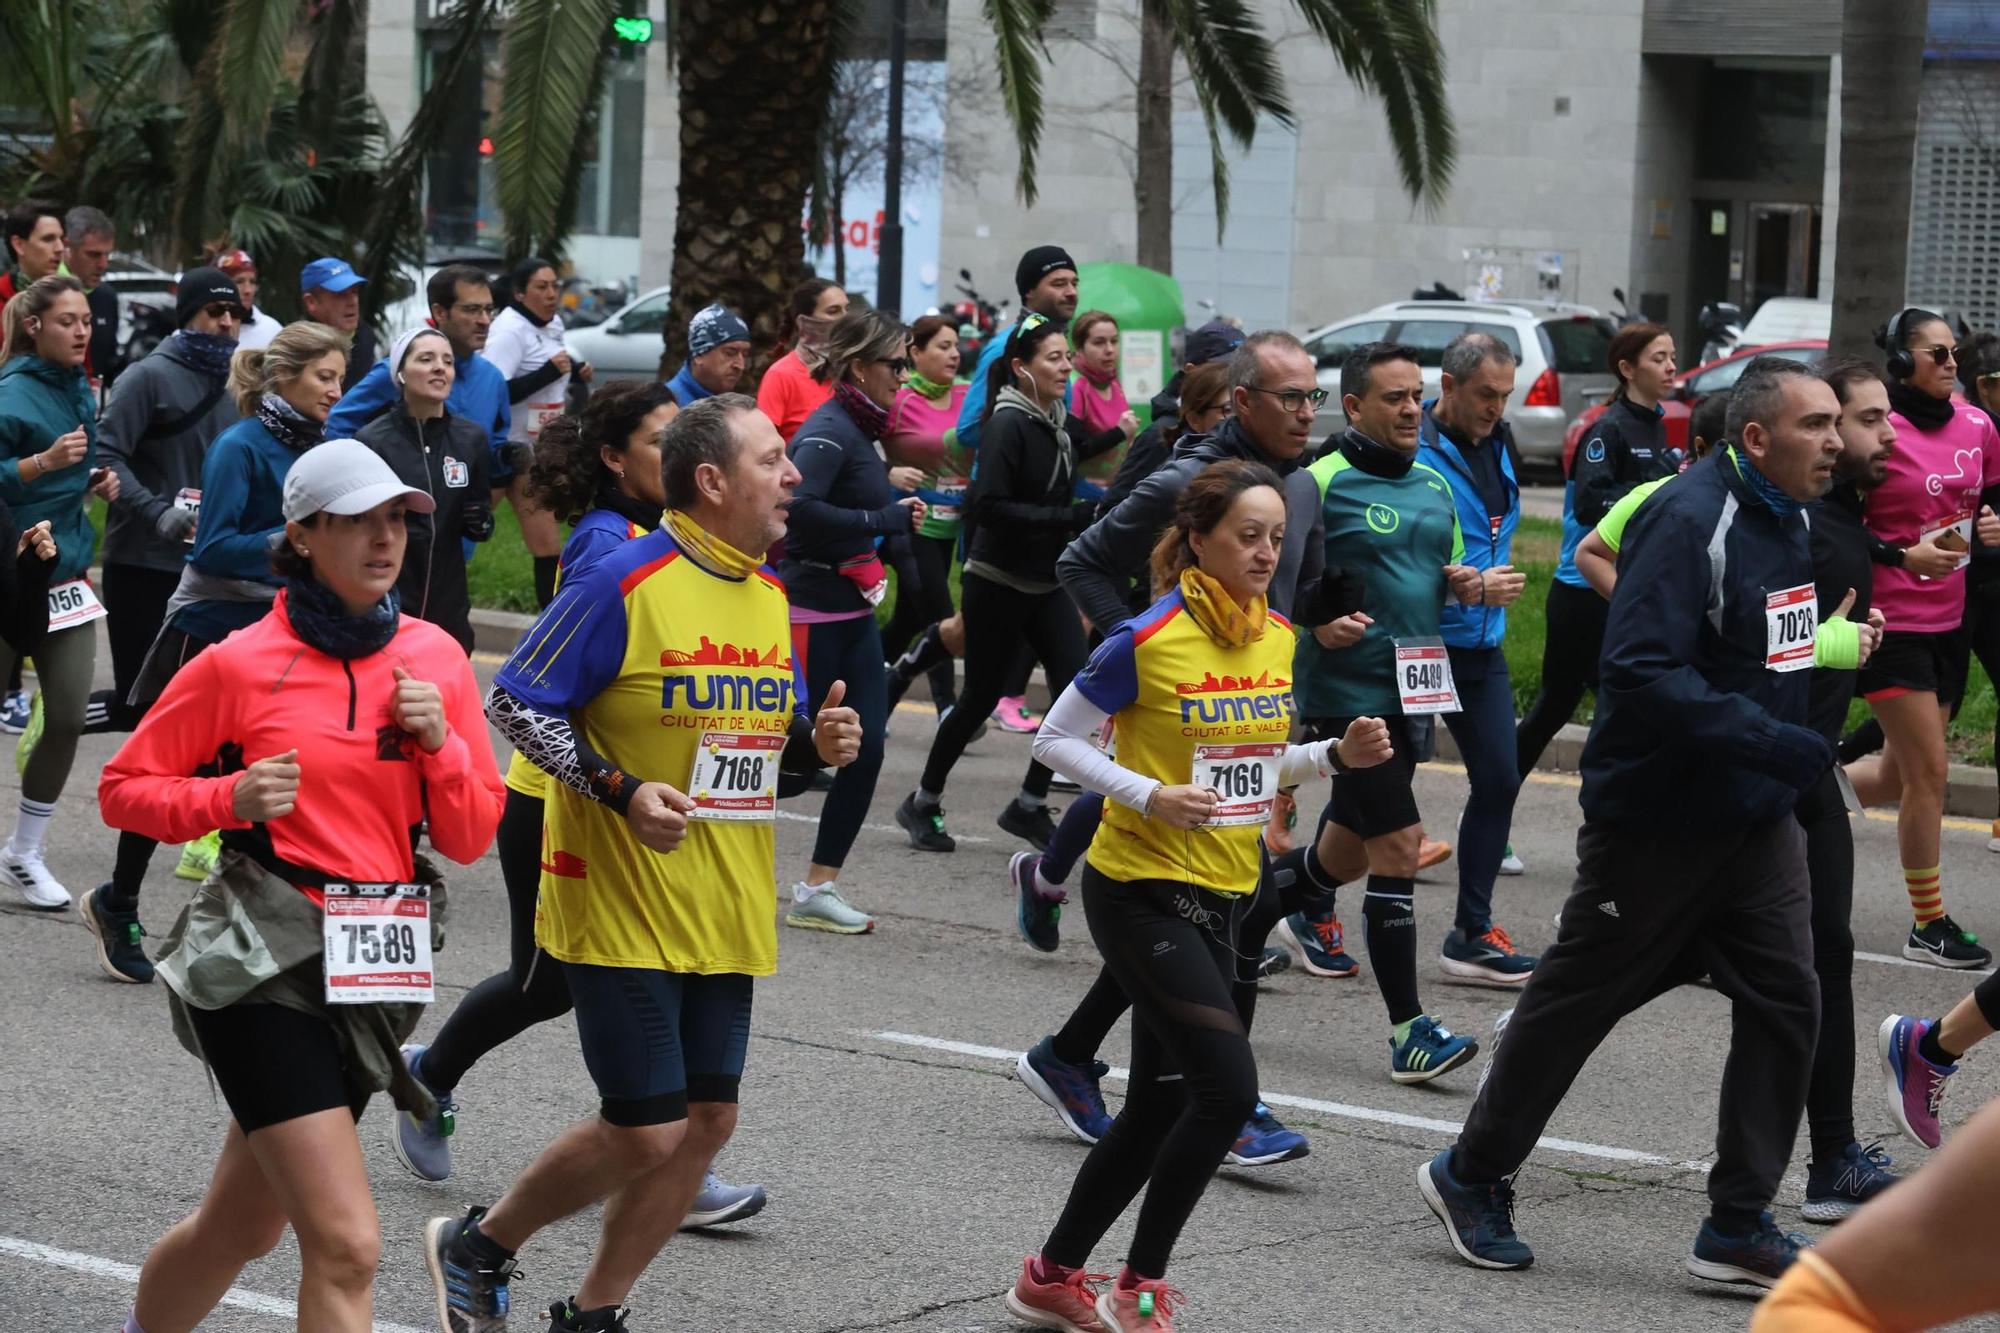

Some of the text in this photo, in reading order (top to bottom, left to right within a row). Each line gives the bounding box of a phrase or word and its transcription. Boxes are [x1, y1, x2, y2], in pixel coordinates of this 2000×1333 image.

[1777, 606, 1814, 645] 7028
[662, 675, 796, 712] runner
[1406, 663, 1442, 690] 6489
[661, 714, 725, 731] CIUTAT
[730, 716, 745, 730] DE
[1182, 726, 1230, 738] CIUTAT
[1236, 725, 1251, 734] DE
[711, 755, 763, 791] 7168
[1210, 763, 1263, 798] 7169
[341, 923, 416, 964] 7589
